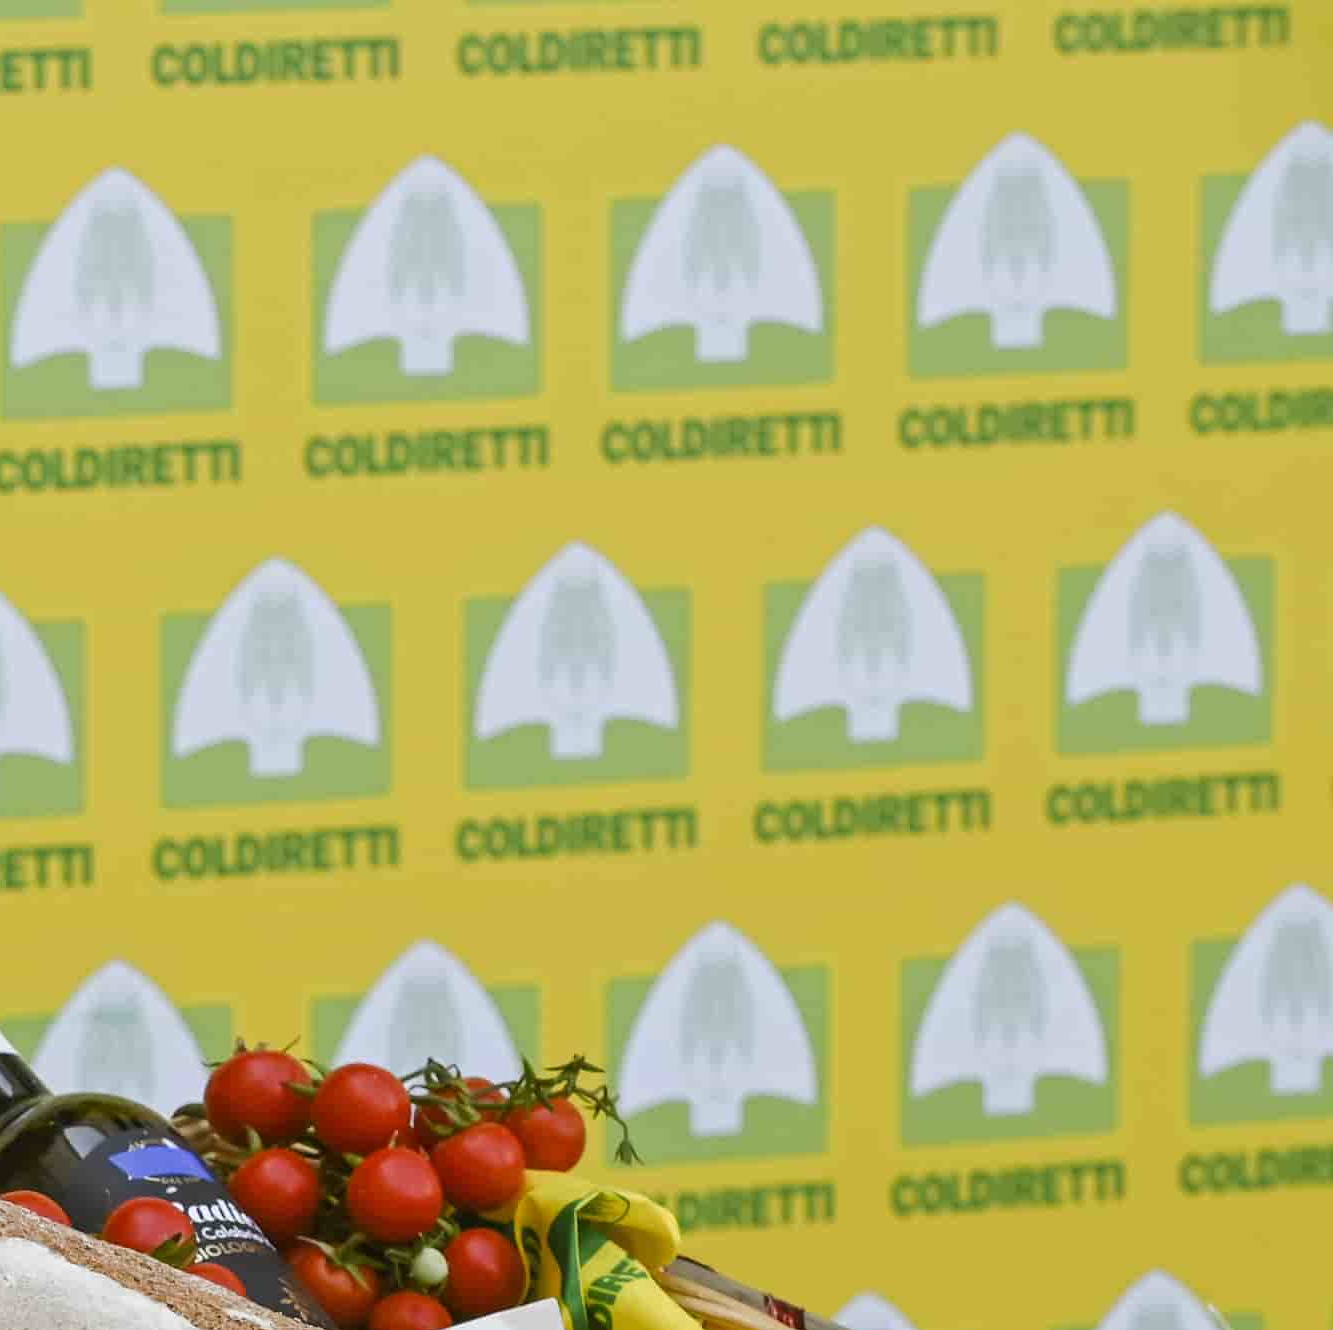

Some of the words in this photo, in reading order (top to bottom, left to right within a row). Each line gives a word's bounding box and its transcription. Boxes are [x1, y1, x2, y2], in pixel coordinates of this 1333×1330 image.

[461, 29, 700, 73] COLDIRETTI
[761, 19, 997, 64] COLDIRETTI
[1055, 8, 1288, 52] COLDIRETTI
[154, 40, 398, 85] COLDIRETTI
[902, 399, 1135, 447] COLDIRETTI
[1190, 391, 1333, 434] COLDIR
[307, 428, 548, 476] COLDIRETTI
[604, 415, 840, 462] COLDIRETTI
[756, 792, 990, 841] COLDIRETTI
[1049, 774, 1278, 823] COLDIRETTI
[155, 828, 398, 880] COLDIRETTI
[458, 810, 696, 860] COLDIRETTI
[894, 1163, 1125, 1216] COLDIRETTI
[1181, 1147, 1333, 1194] COLDIR
[675, 1183, 836, 1232] DIRETTI
